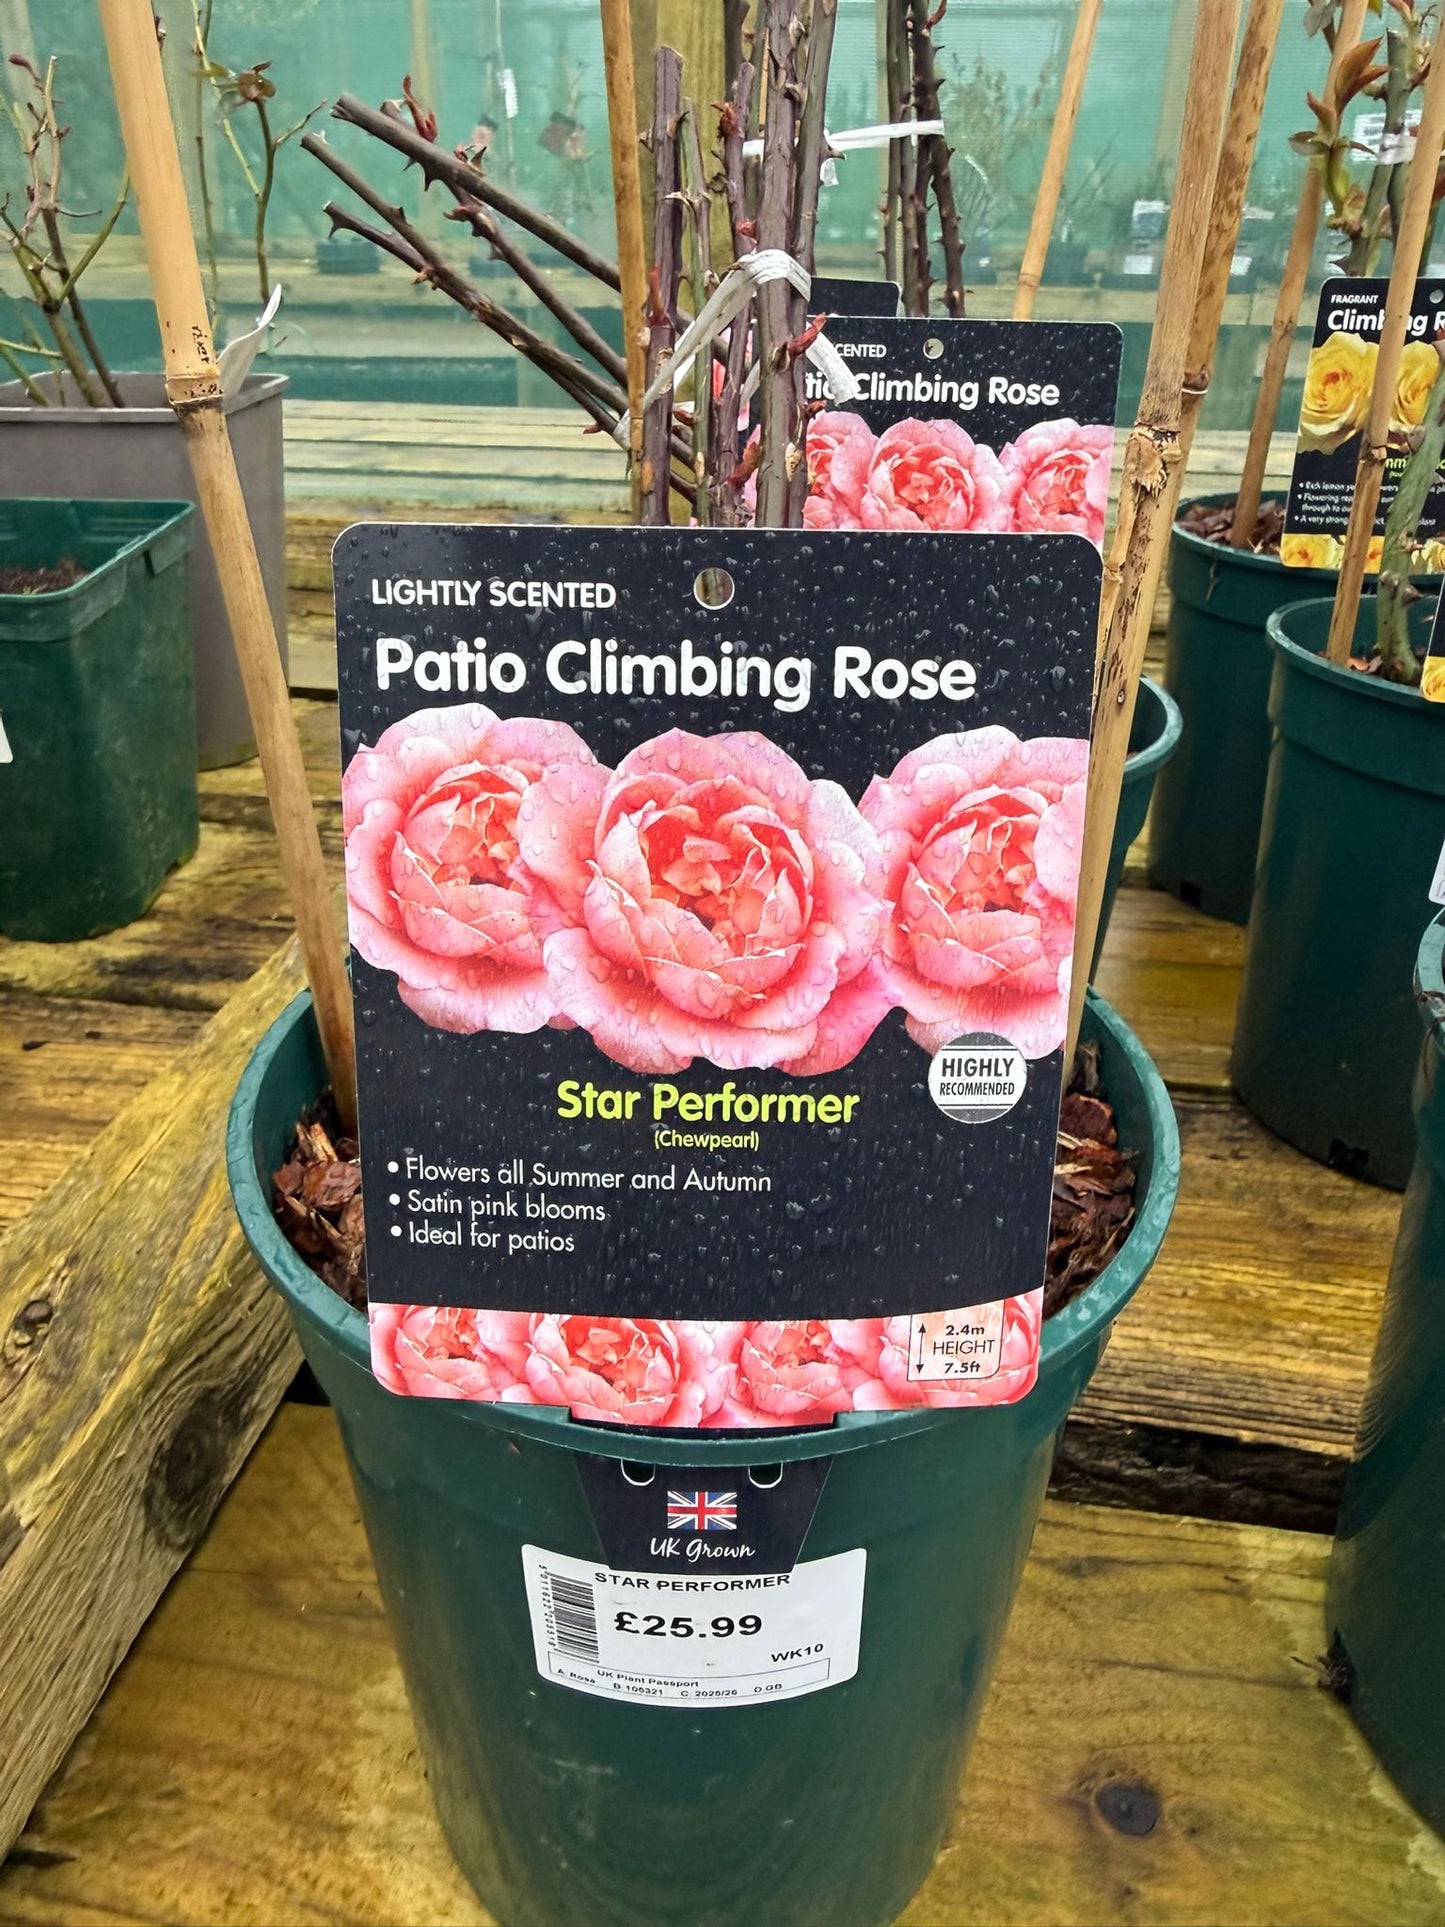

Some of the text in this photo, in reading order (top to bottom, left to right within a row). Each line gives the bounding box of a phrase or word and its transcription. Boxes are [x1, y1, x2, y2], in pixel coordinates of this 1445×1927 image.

[1330, 294, 1379, 304] FRAGRANT
[835, 343, 887, 358] CENTED
[853, 371, 980, 411] Climbing
[988, 376, 1060, 406] Rose
[372, 579, 617, 608] LIGHTLY SCENTED
[376, 637, 977, 713] Patio Climbing Rose
[939, 1058, 1015, 1097] HIGHLY RECOMMENDED
[557, 1080, 861, 1124] Star Performer
[654, 1130, 760, 1152] (Chewpearl)
[406, 1155, 771, 1192] Flowers all Summer and Autumn
[407, 1189, 606, 1221] Satin pink blooms
[409, 1220, 575, 1256] Ideal for patios
[945, 1325, 985, 1336] 2.4m
[933, 1340, 995, 1355] HEIGHT
[944, 1360, 981, 1374] 7.5ft
[650, 1537, 756, 1562] UK Grown
[594, 1572, 791, 1592] STAR PERFORMER
[614, 1611, 762, 1638] £25.99
[771, 1643, 824, 1663] WK10
[597, 1670, 699, 1688] UK Plant Passport
